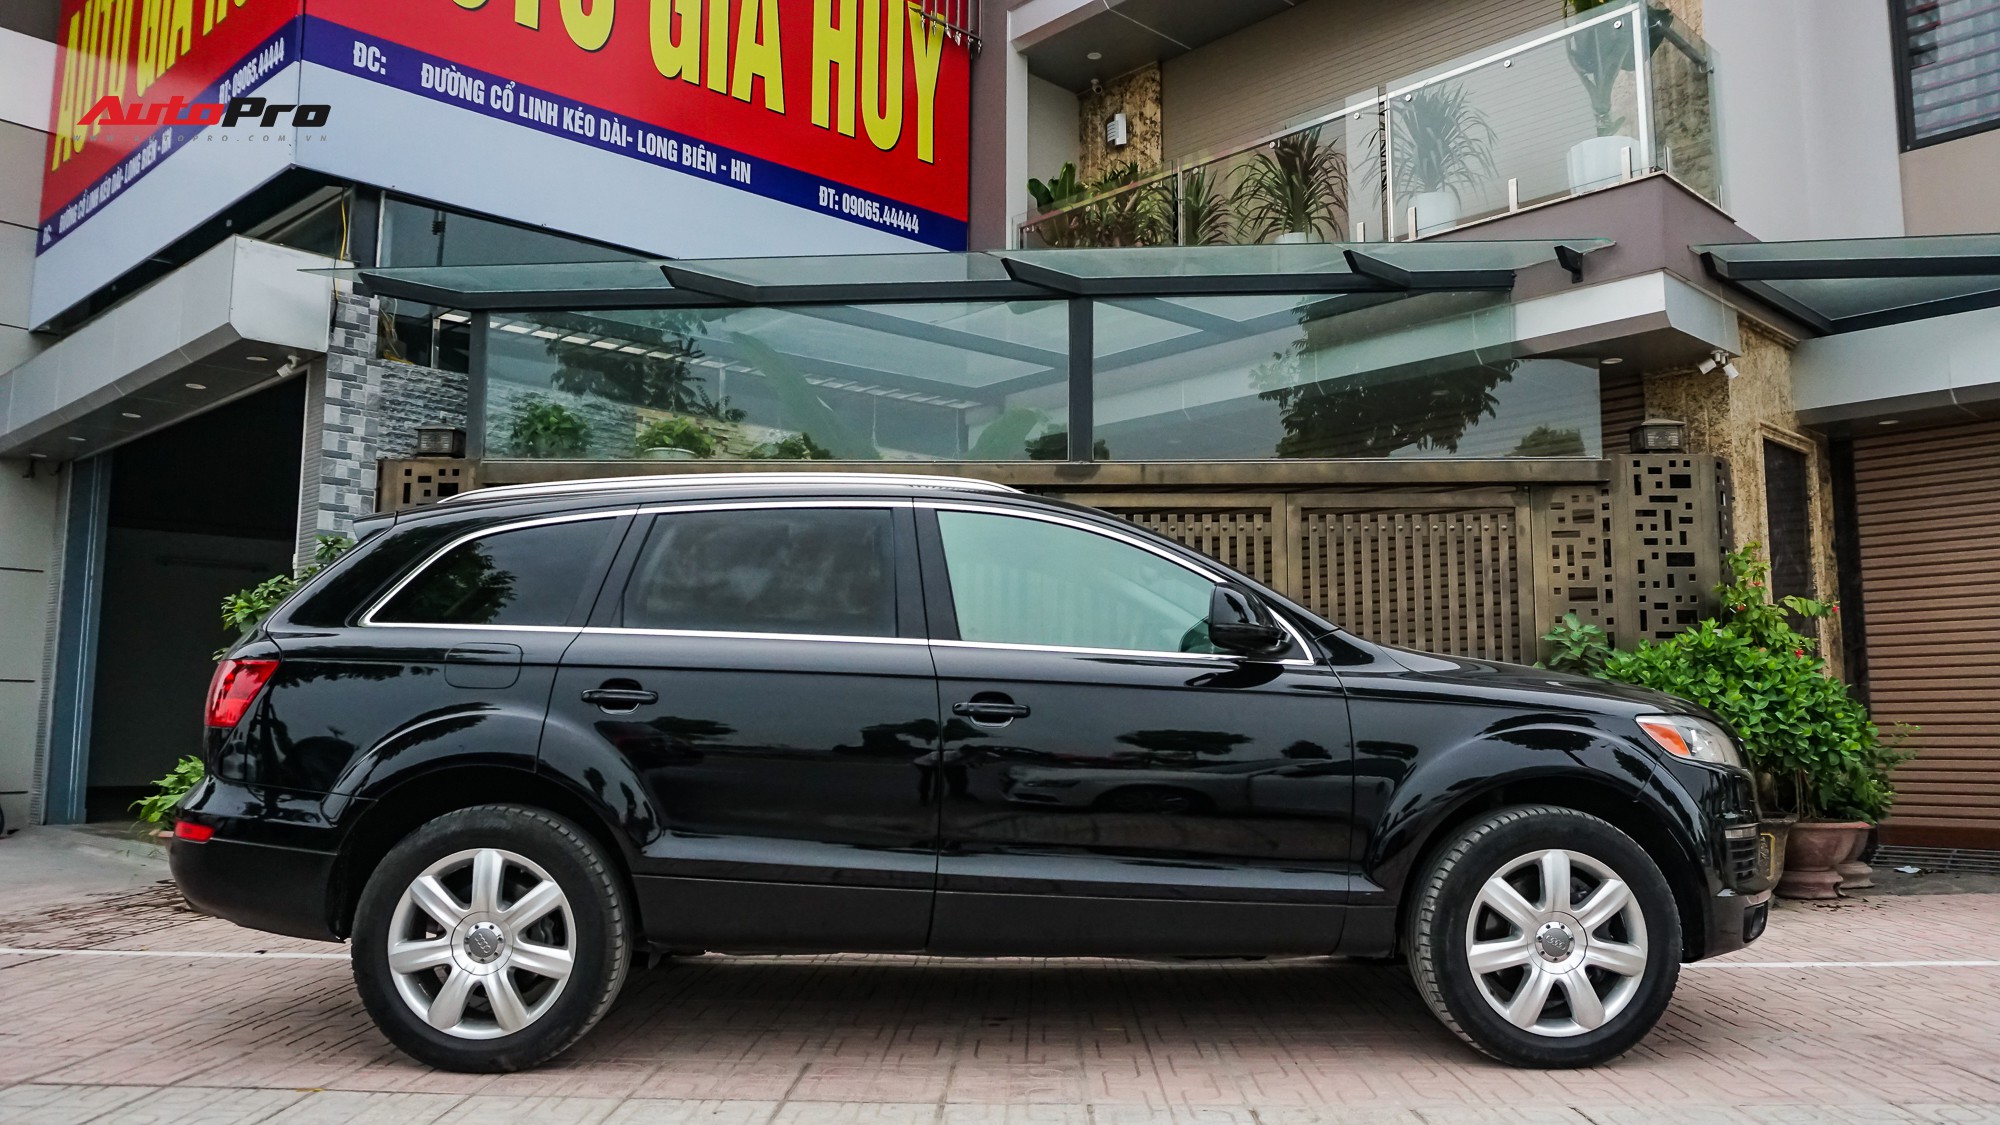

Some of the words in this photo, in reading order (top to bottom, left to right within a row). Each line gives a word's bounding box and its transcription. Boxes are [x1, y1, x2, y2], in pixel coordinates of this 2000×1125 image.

[353, 41, 387, 75] ĐC:
[421, 62, 486, 105] ĐƯỜNG
[490, 81, 516, 113] CỔ
[519, 93, 559, 127] LINH
[563, 106, 595, 138] KÉO
[637, 130, 678, 163] LONG
[682, 144, 717, 175] BIÊN
[730, 158, 751, 185] HN
[811, 0, 945, 165] HUY
[819, 185, 839, 211] ĐT:
[842, 193, 919, 234] 09065.44444
